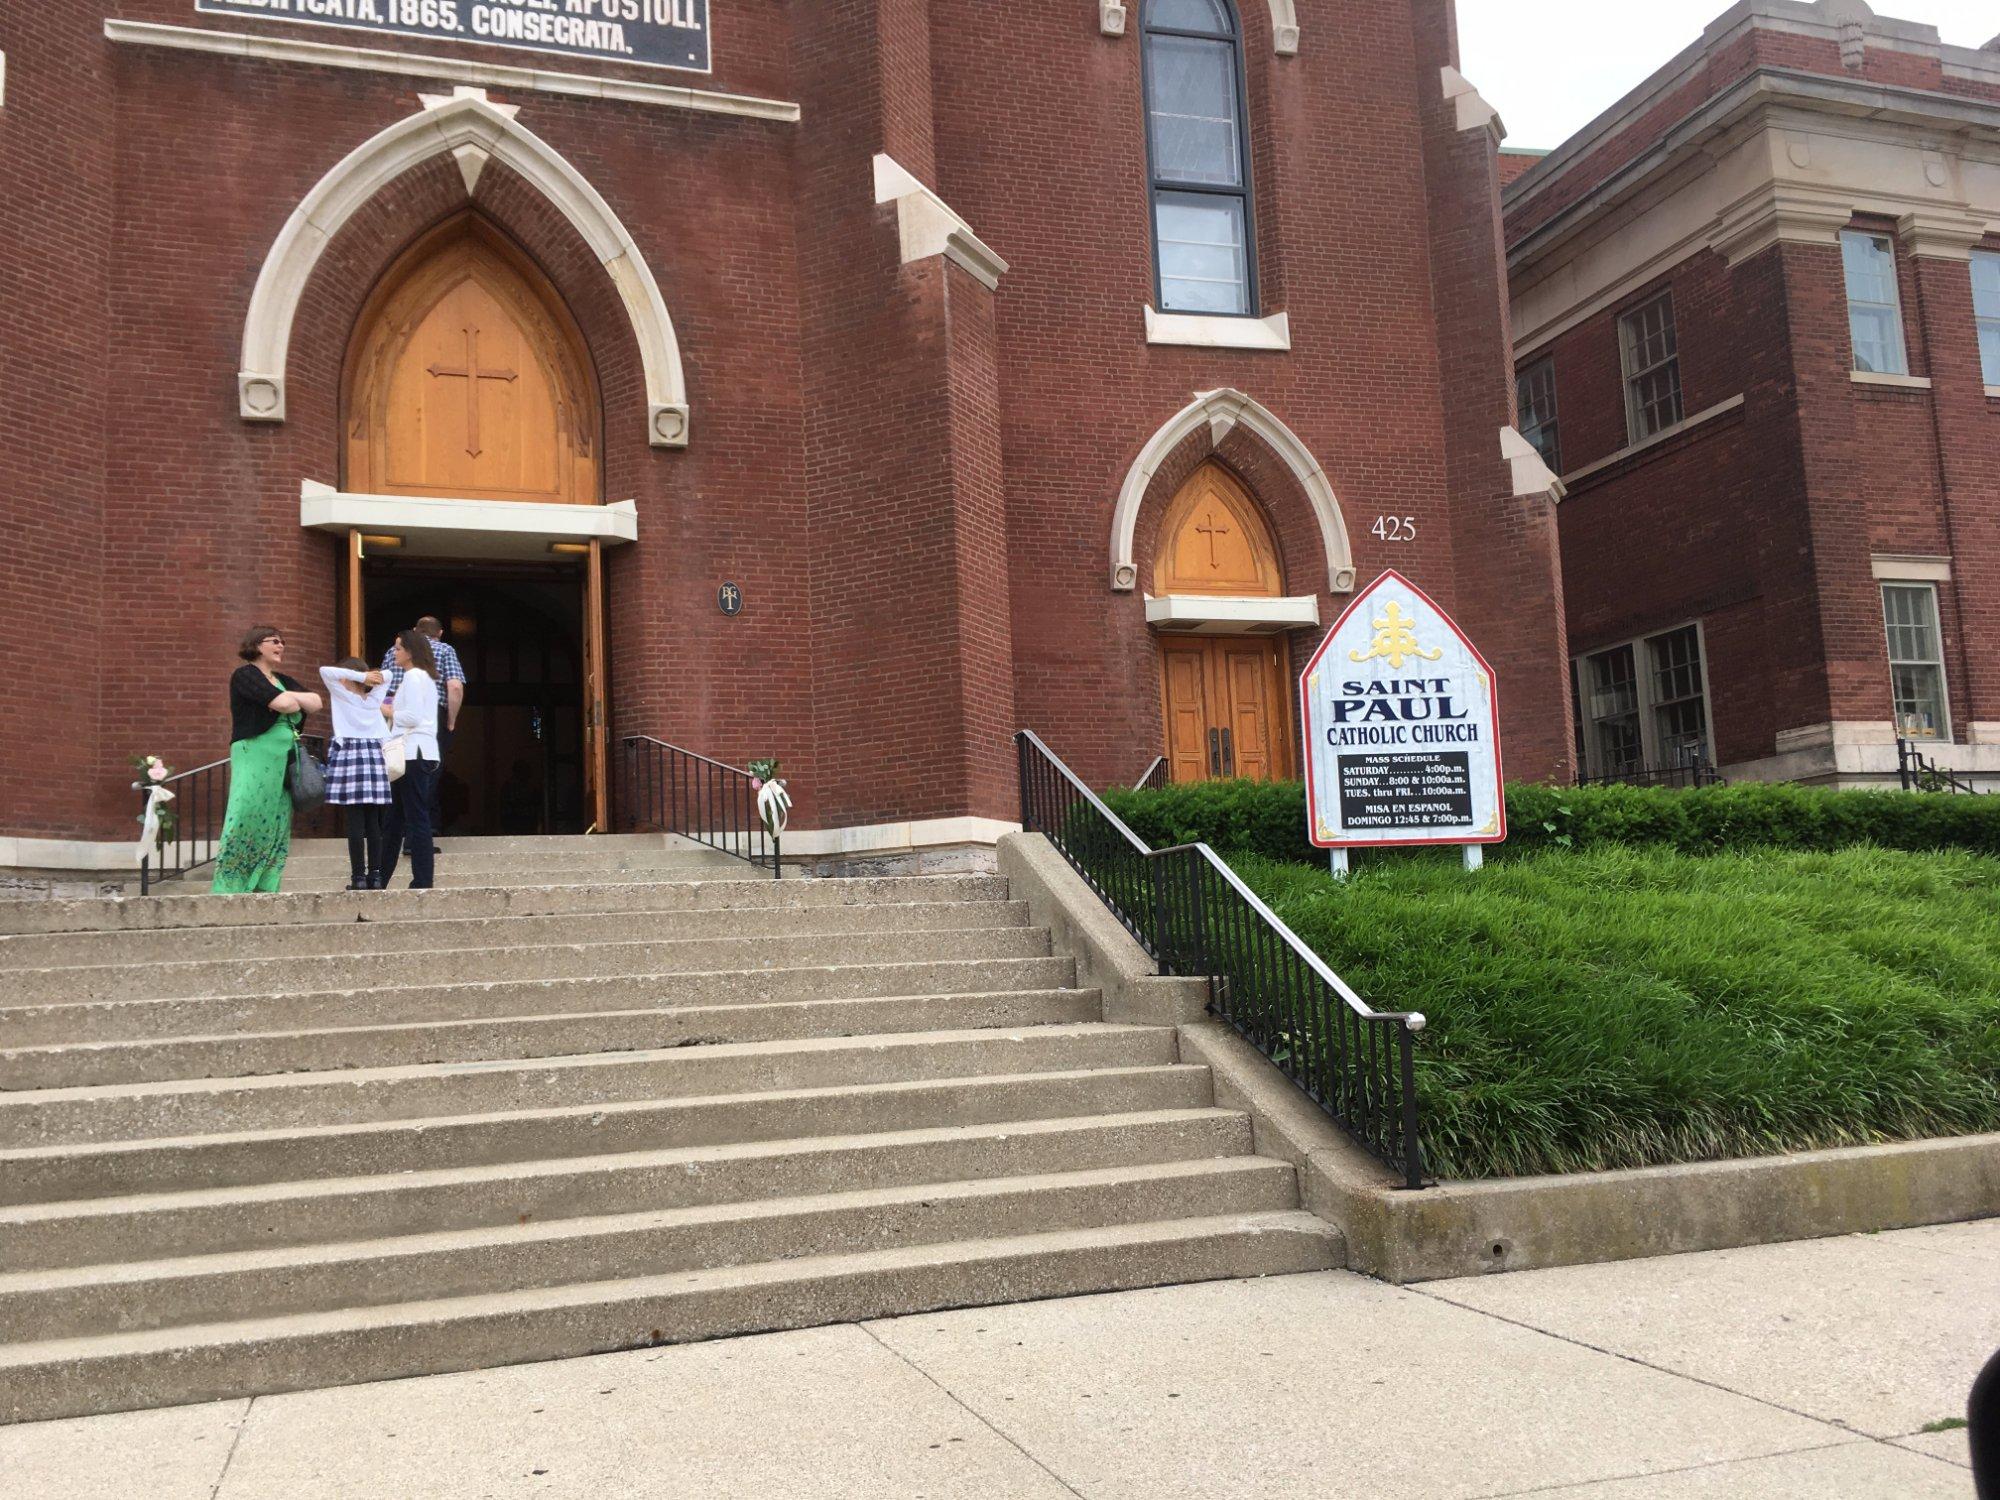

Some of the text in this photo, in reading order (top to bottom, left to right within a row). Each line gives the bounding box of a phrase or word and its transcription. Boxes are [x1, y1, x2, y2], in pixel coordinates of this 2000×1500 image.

[388, 0, 465, 32] 1865.
[471, 4, 634, 55] CONSECRATA.
[1371, 515, 1416, 541] 425
[1341, 678, 1451, 696] SAINT
[1331, 696, 1469, 723] PAUL
[1327, 723, 1479, 746] CATHOLIC CHURCH
[1365, 755, 1441, 764] MASS SCHEDULE
[1425, 764, 1465, 775] 4:00p.m.
[1411, 776, 1420, 785] &
[1421, 776, 1466, 785] 10:00a.m.
[1344, 788, 1371, 797] TUES.
[1373, 788, 1393, 797] thru
[1365, 803, 1453, 814] MISA EN ESPANOL
[1347, 814, 1472, 826] DOMINGO 12:45 & 7:00p.m.
